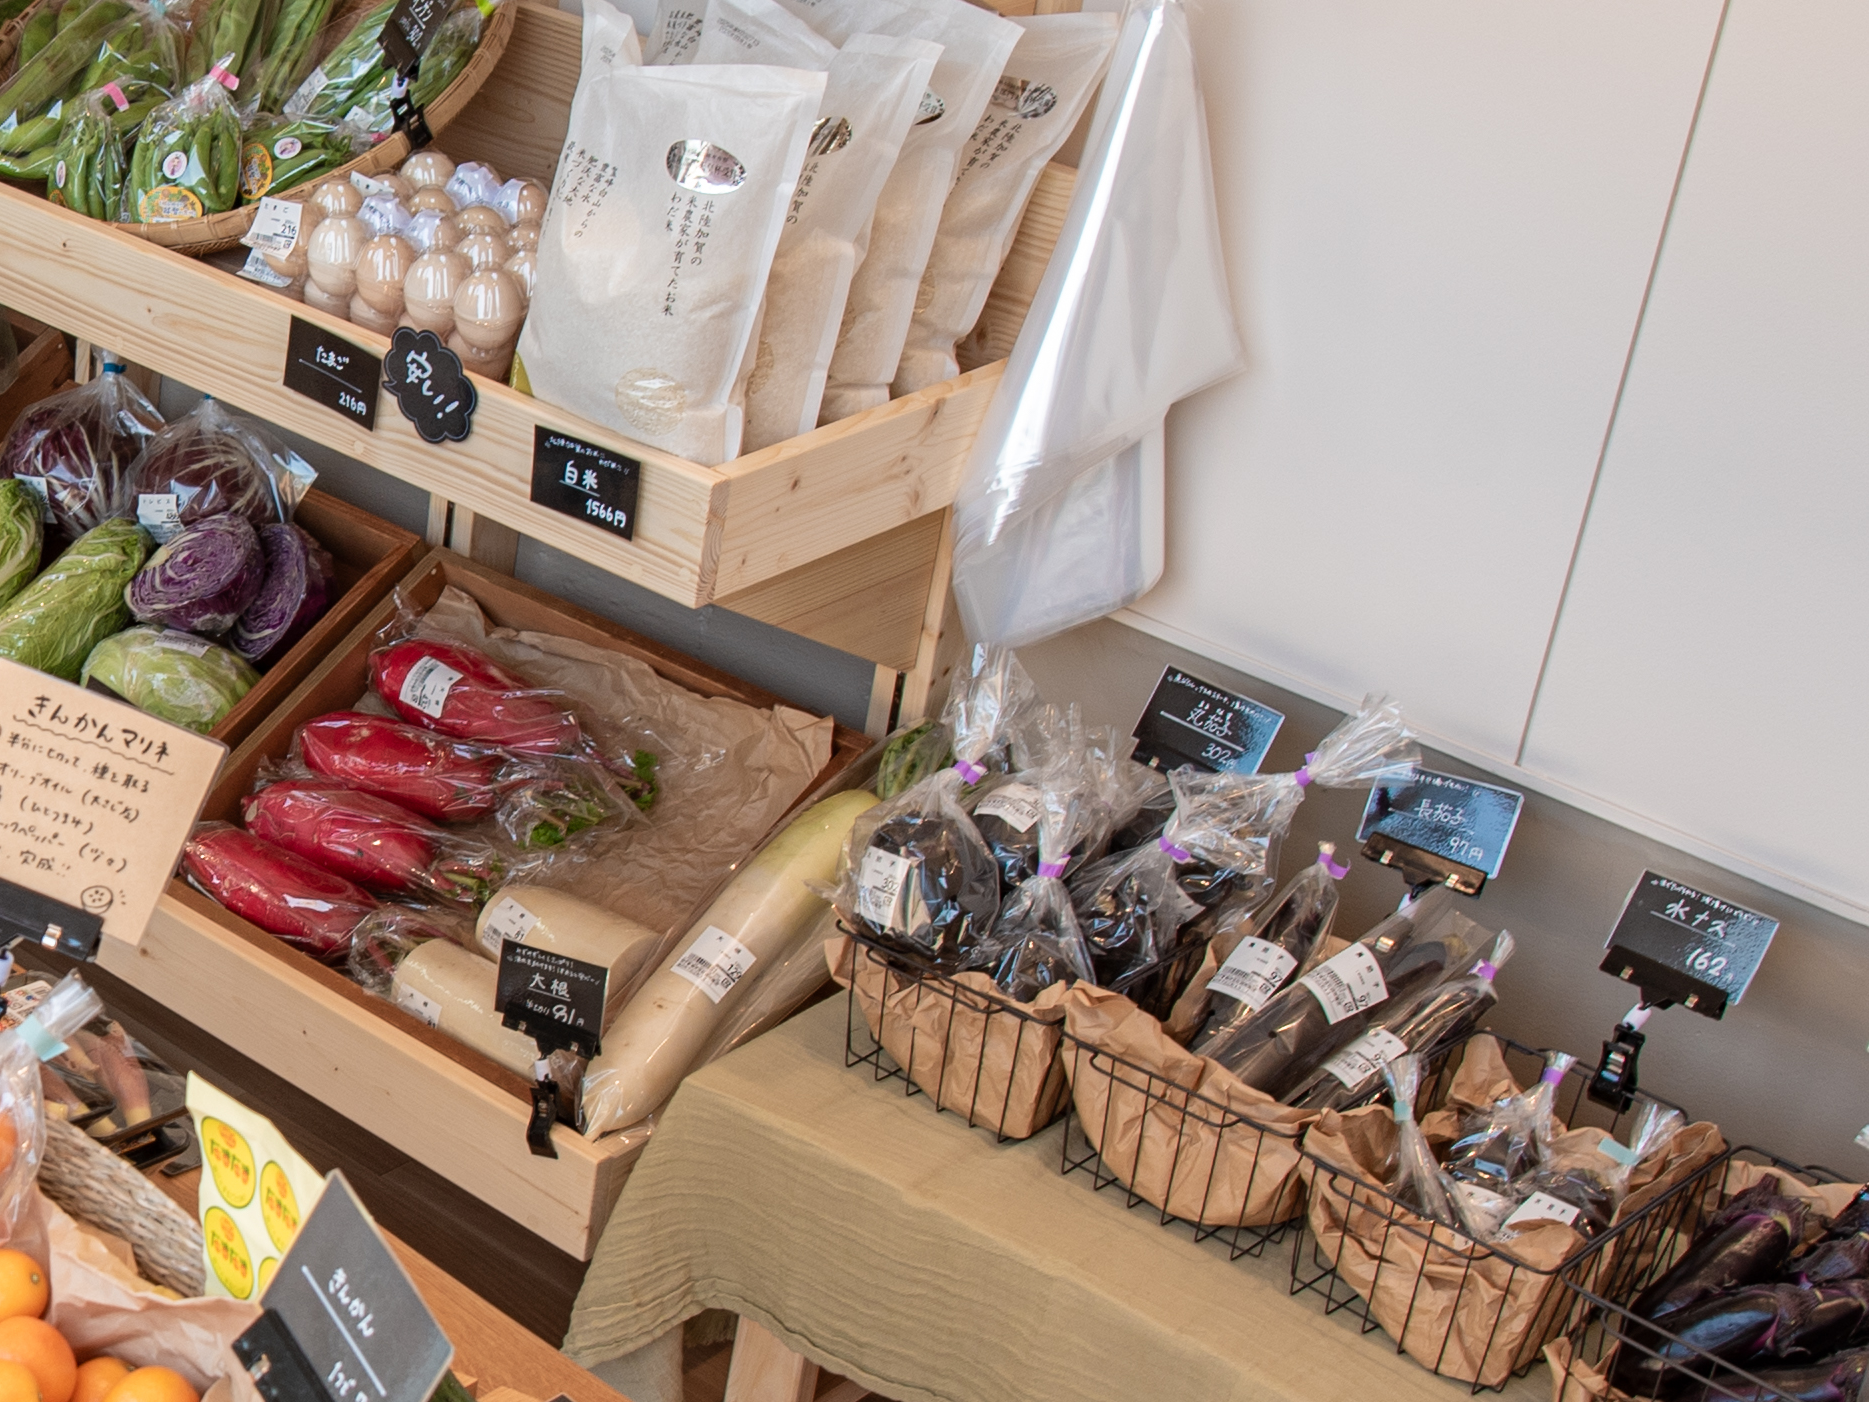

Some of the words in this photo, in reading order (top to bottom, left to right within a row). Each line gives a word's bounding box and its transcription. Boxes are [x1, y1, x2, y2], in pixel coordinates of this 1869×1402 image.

[665, 192, 682, 232] わだ米
[281, 224, 297, 236] 216
[691, 200, 715, 266] 北陸加賀の
[662, 195, 698, 317] 米農家が育てたお米
[316, 345, 350, 371] たまご
[338, 392, 367, 416] 216円
[564, 460, 598, 490] 白米
[585, 498, 627, 528] 1566円
[27, 694, 170, 763] きんかんマリネ
[1414, 798, 1466, 826] 長茄子
[1449, 836, 1484, 861] 97円
[1665, 898, 1727, 938] 水ナス
[529, 972, 570, 998] 大根
[328, 1267, 375, 1338] きんかん
